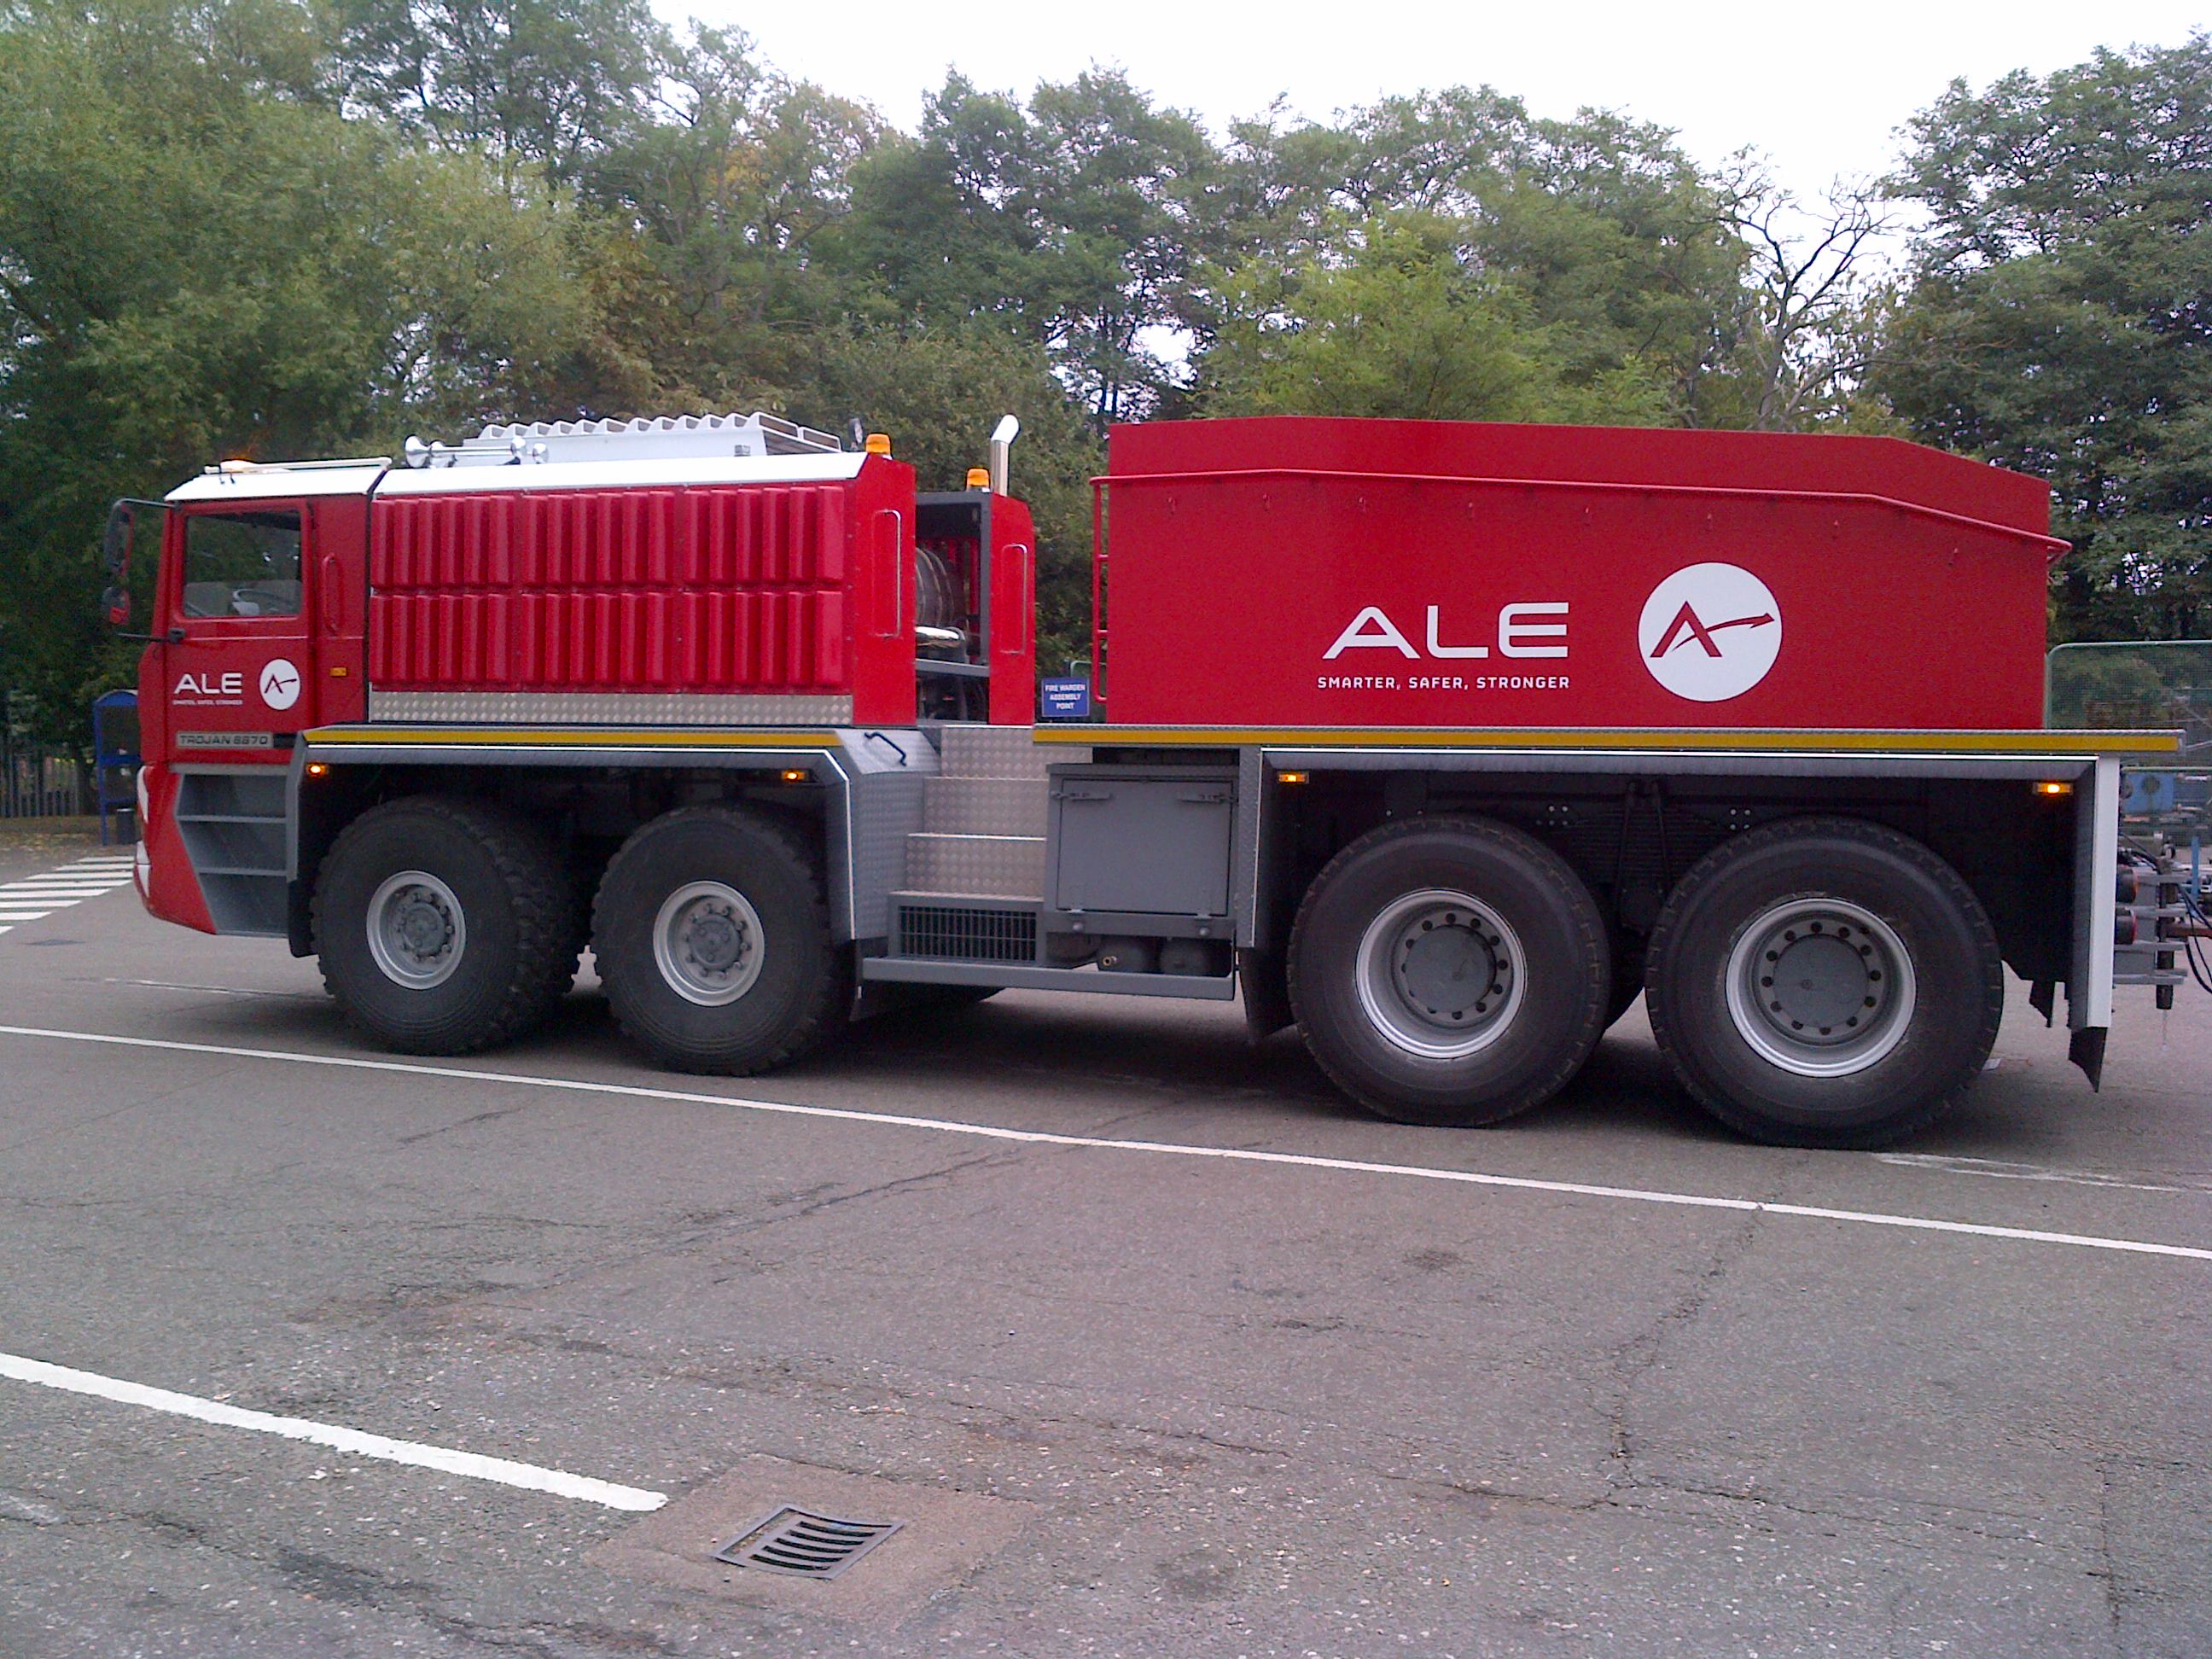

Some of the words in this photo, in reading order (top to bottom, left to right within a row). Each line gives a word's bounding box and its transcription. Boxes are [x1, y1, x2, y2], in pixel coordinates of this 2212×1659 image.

[1322, 602, 1569, 660] ALE
[173, 672, 243, 695] ALE
[1317, 676, 1401, 690] SMARTER,
[1408, 676, 1469, 690] SAFER,
[1476, 676, 1570, 690] STRONGER
[179, 735, 232, 746] TROJAN
